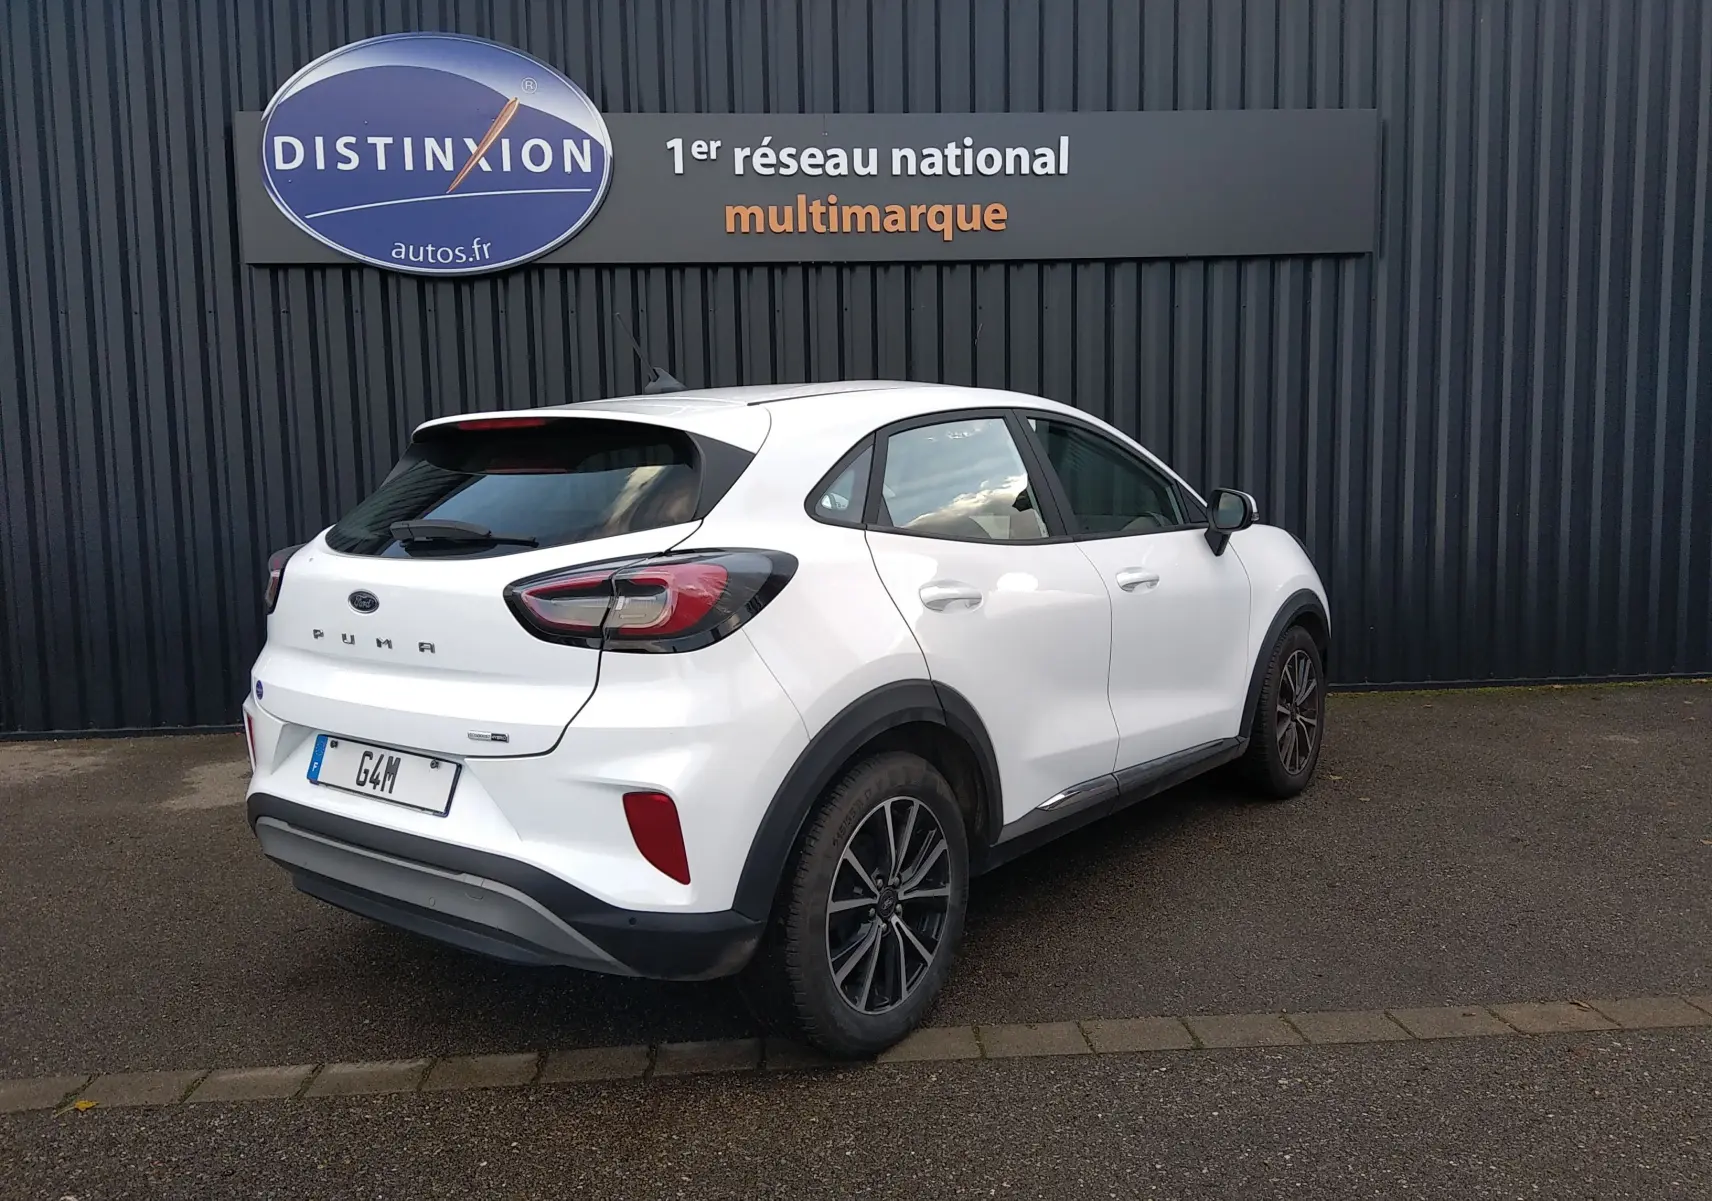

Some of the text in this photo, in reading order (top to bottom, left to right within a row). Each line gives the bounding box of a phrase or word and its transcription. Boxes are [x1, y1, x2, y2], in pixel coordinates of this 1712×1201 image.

[273, 134, 593, 174] DISTINXION
[666, 135, 1070, 176] 1er réseau national
[724, 194, 1008, 241] multimarque
[390, 237, 492, 265] autos.fr
[312, 628, 436, 654] PUMA
[311, 761, 319, 772] F
[355, 750, 402, 794] G4M
